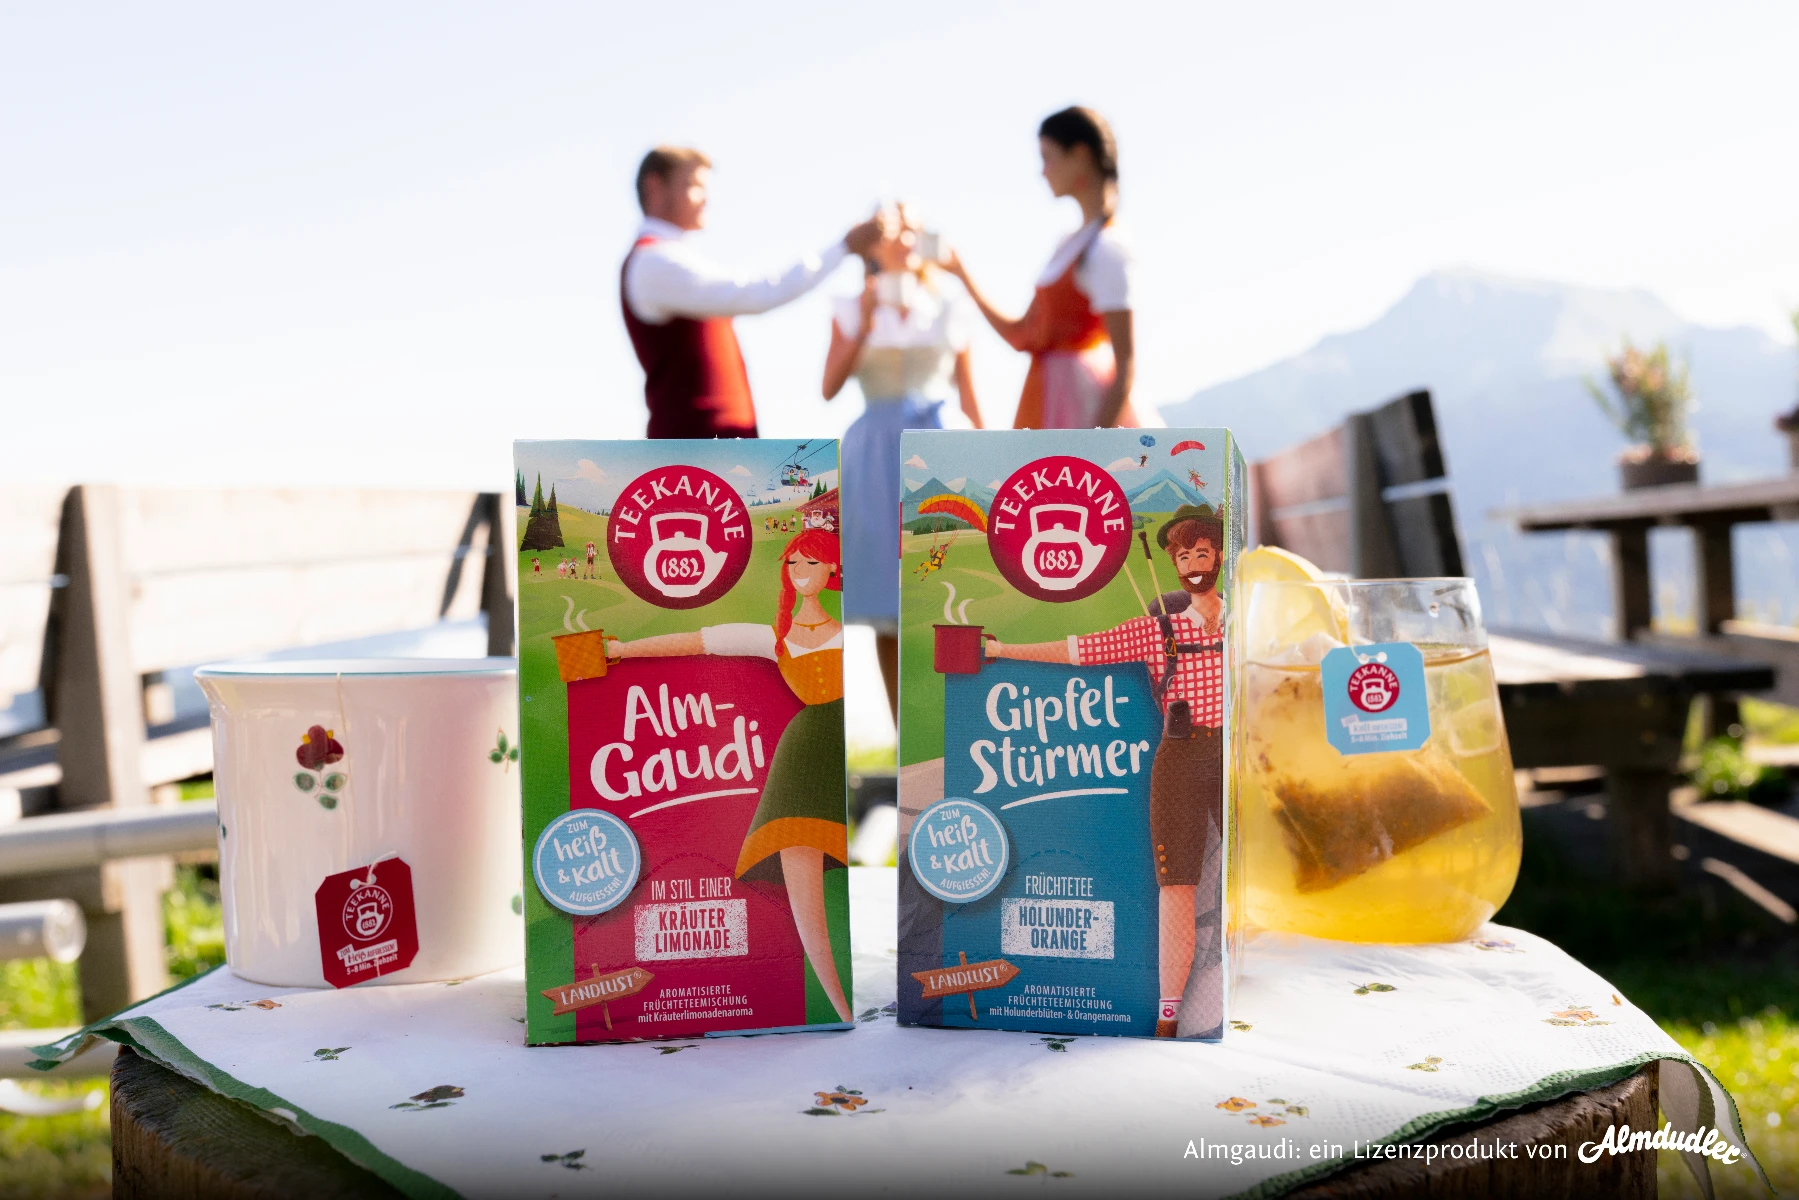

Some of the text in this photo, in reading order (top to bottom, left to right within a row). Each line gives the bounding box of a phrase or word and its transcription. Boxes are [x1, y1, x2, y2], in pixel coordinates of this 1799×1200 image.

[614, 475, 745, 544] TEEKANNE
[995, 466, 1124, 535] TEEKANNE
[661, 557, 703, 578] 1882
[1039, 549, 1080, 572] 1882
[1350, 665, 1398, 692] TEEKANNE
[623, 683, 735, 742] Alm-
[985, 675, 1129, 744] Gipfel-
[590, 715, 765, 802] Gaudi
[969, 736, 1150, 794] Stürmer
[940, 808, 960, 821] ZUM
[566, 819, 589, 834] ZUM
[927, 814, 978, 848] heiß
[553, 825, 607, 862] heiß
[930, 855, 942, 870] &
[557, 868, 570, 883] &
[940, 868, 991, 890] AUFGIESSEN!
[1025, 871, 1094, 897] FRÜCHTETEE
[568, 876, 623, 902] AUFGIESSEN!
[651, 877, 732, 900] IM STIL EINER
[345, 889, 390, 921] TEEKANNE
[362, 919, 377, 930] 1882
[659, 906, 726, 931] KRÄUTER
[1019, 906, 1100, 929] HOLUNDER-
[655, 929, 731, 953] LIMONADE
[1031, 928, 1088, 951] ORANGE
[359, 962, 373, 972] Min.
[659, 984, 731, 999] AROMATISIERTE
[1008, 995, 1112, 1010] FRÜCHTETEEMISCHUNG
[1024, 984, 1096, 998] AROMATISIERTE
[643, 995, 748, 1012] FRÜCHTETEEMISCHUNG
[989, 1006, 1131, 1023] mit Holunderblüten- & Orangenaroma
[637, 1007, 753, 1024] mit Kräuterlimonadenaroma
